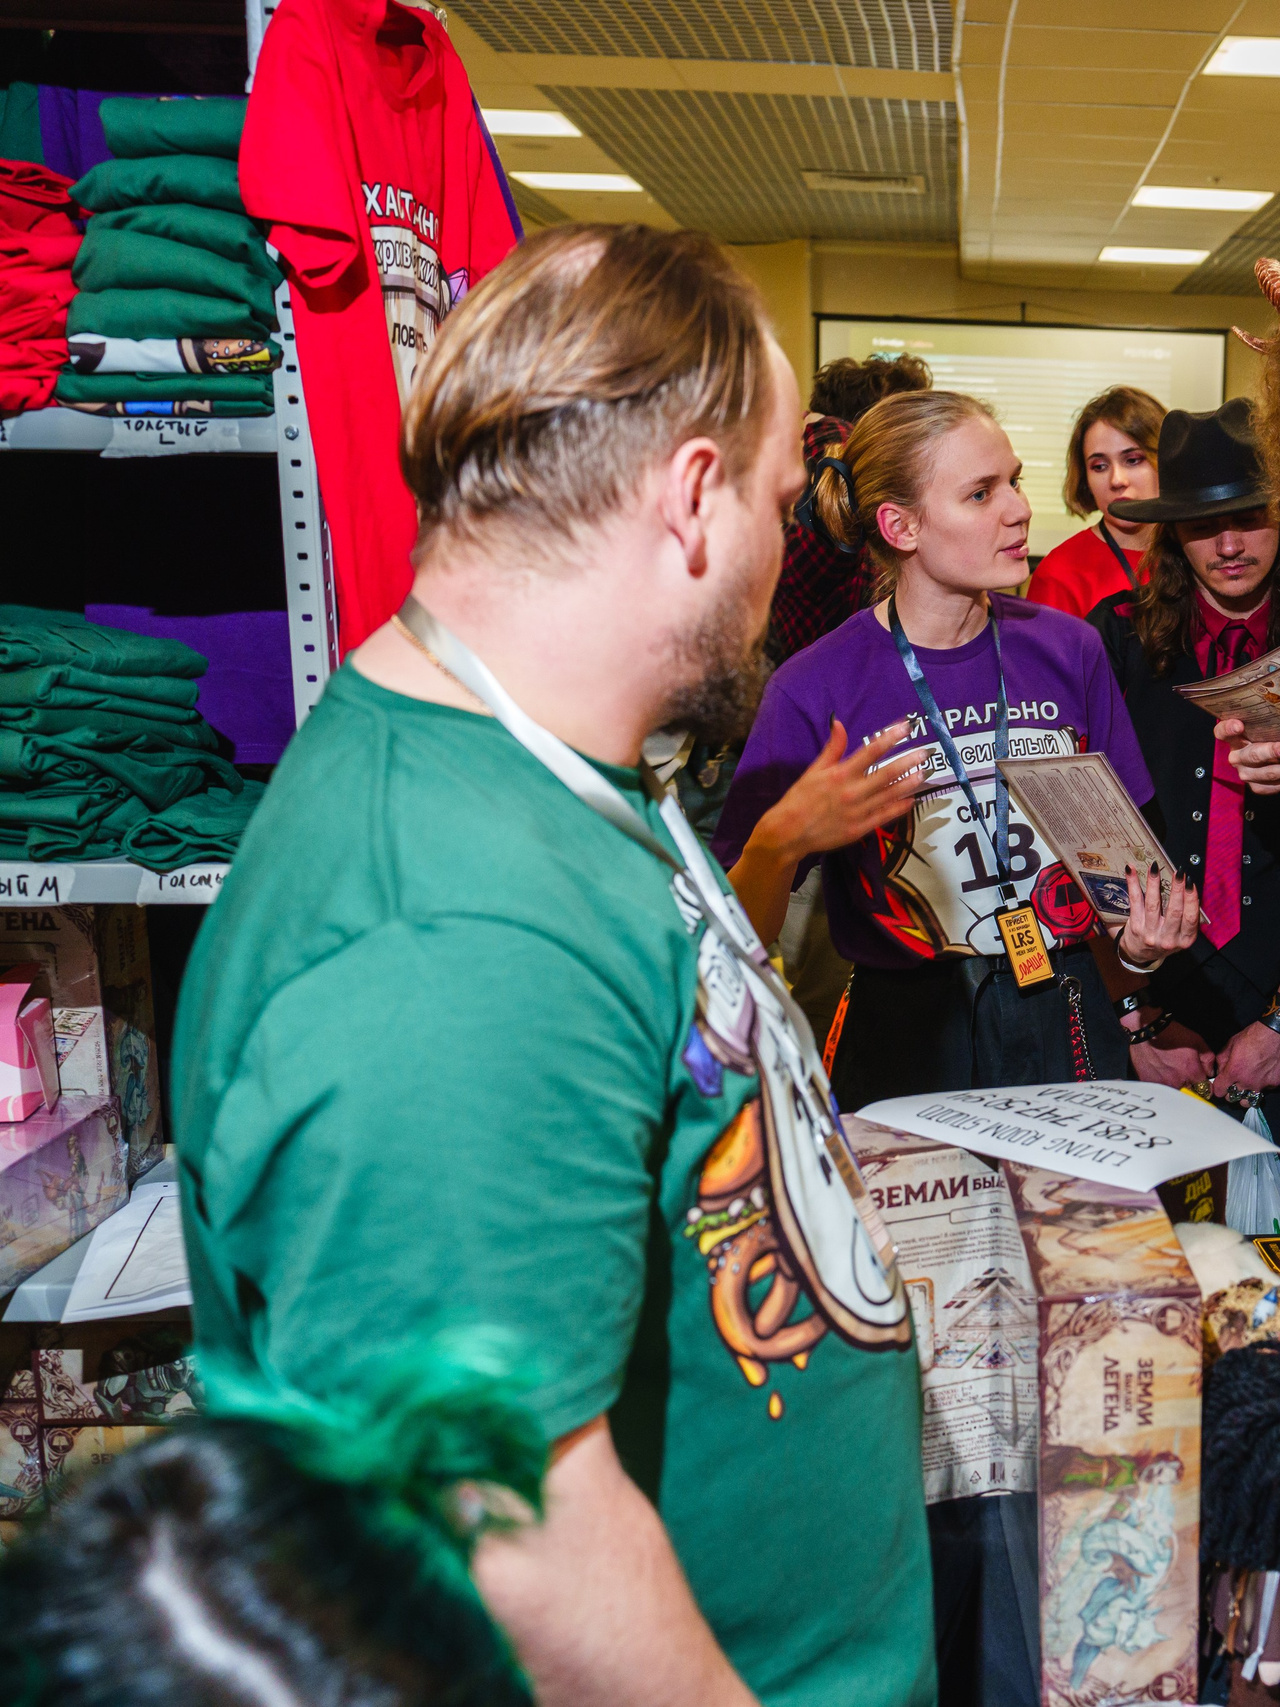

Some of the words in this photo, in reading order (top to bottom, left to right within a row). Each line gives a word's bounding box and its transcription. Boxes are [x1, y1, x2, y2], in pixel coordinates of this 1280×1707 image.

[124, 419, 209, 437] ТОЛСТЫЙ
[953, 822, 1042, 894] 18
[1011, 930, 1035, 949] LRS
[1018, 952, 1047, 981] МАША
[1015, 1104, 1081, 1128] 747
[1076, 1118, 1147, 1142] 981
[978, 1120, 1045, 1148] ROOM
[1134, 1135, 1173, 1150] 8
[1042, 1137, 1133, 1168] LIVING
[869, 1174, 969, 1210] ЗЕМЛИ
[1104, 1356, 1120, 1435] ЛЕГЕНД
[1137, 1357, 1154, 1427] ЗЕМЛИ
